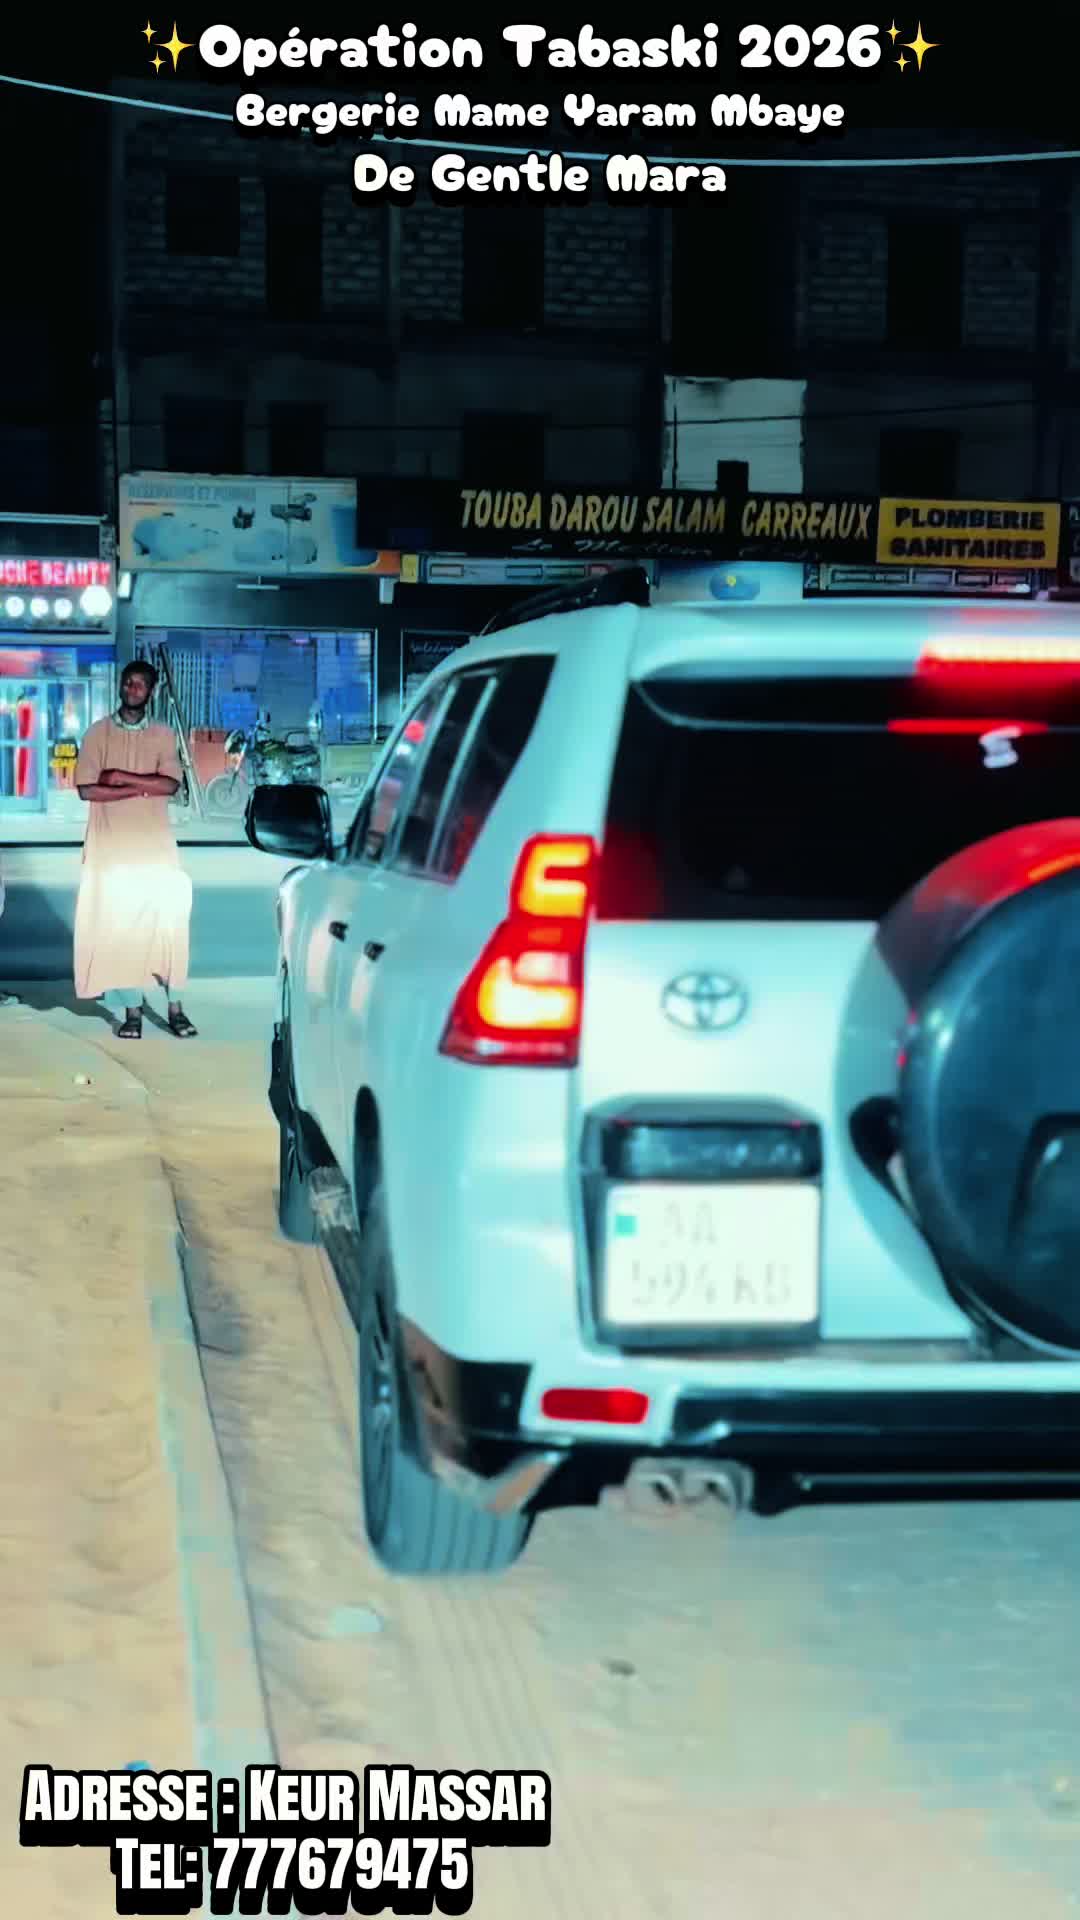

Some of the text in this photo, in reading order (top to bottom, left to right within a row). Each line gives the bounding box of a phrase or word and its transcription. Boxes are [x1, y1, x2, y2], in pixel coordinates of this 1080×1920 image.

[460, 489, 872, 540] TOUBA DAROU SALAM CARREAUX
[895, 507, 1044, 531] PLOMBERIE
[890, 536, 1046, 559] SANITAIRES
[41, 561, 111, 586] BEAUTY
